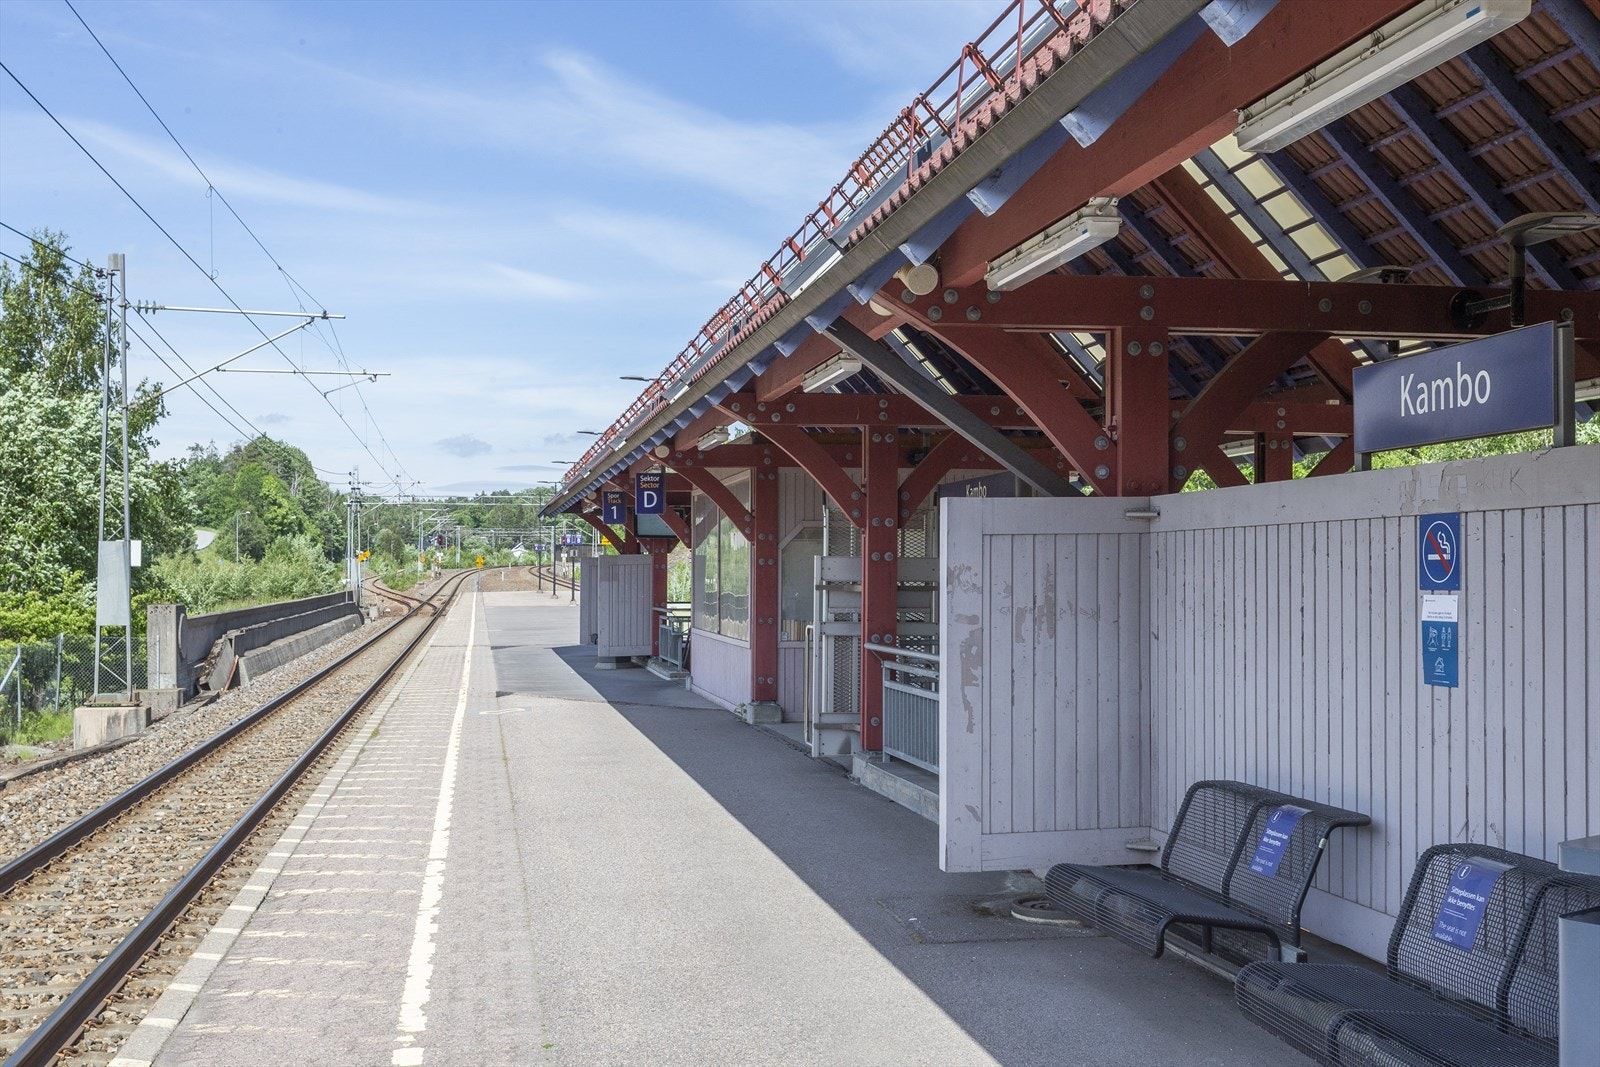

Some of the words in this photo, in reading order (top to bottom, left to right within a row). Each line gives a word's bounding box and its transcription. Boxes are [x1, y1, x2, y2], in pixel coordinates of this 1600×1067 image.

[1400, 361, 1491, 417] Kambo
[644, 491, 658, 508] D
[610, 506, 617, 520] 1
[1451, 886, 1476, 900] Sitteplassen
[1476, 894, 1485, 903] kan
[1448, 896, 1456, 904] ikke
[1456, 899, 1476, 911] benyttes
[1446, 924, 1456, 932] seat
[1459, 929, 1467, 937] not
